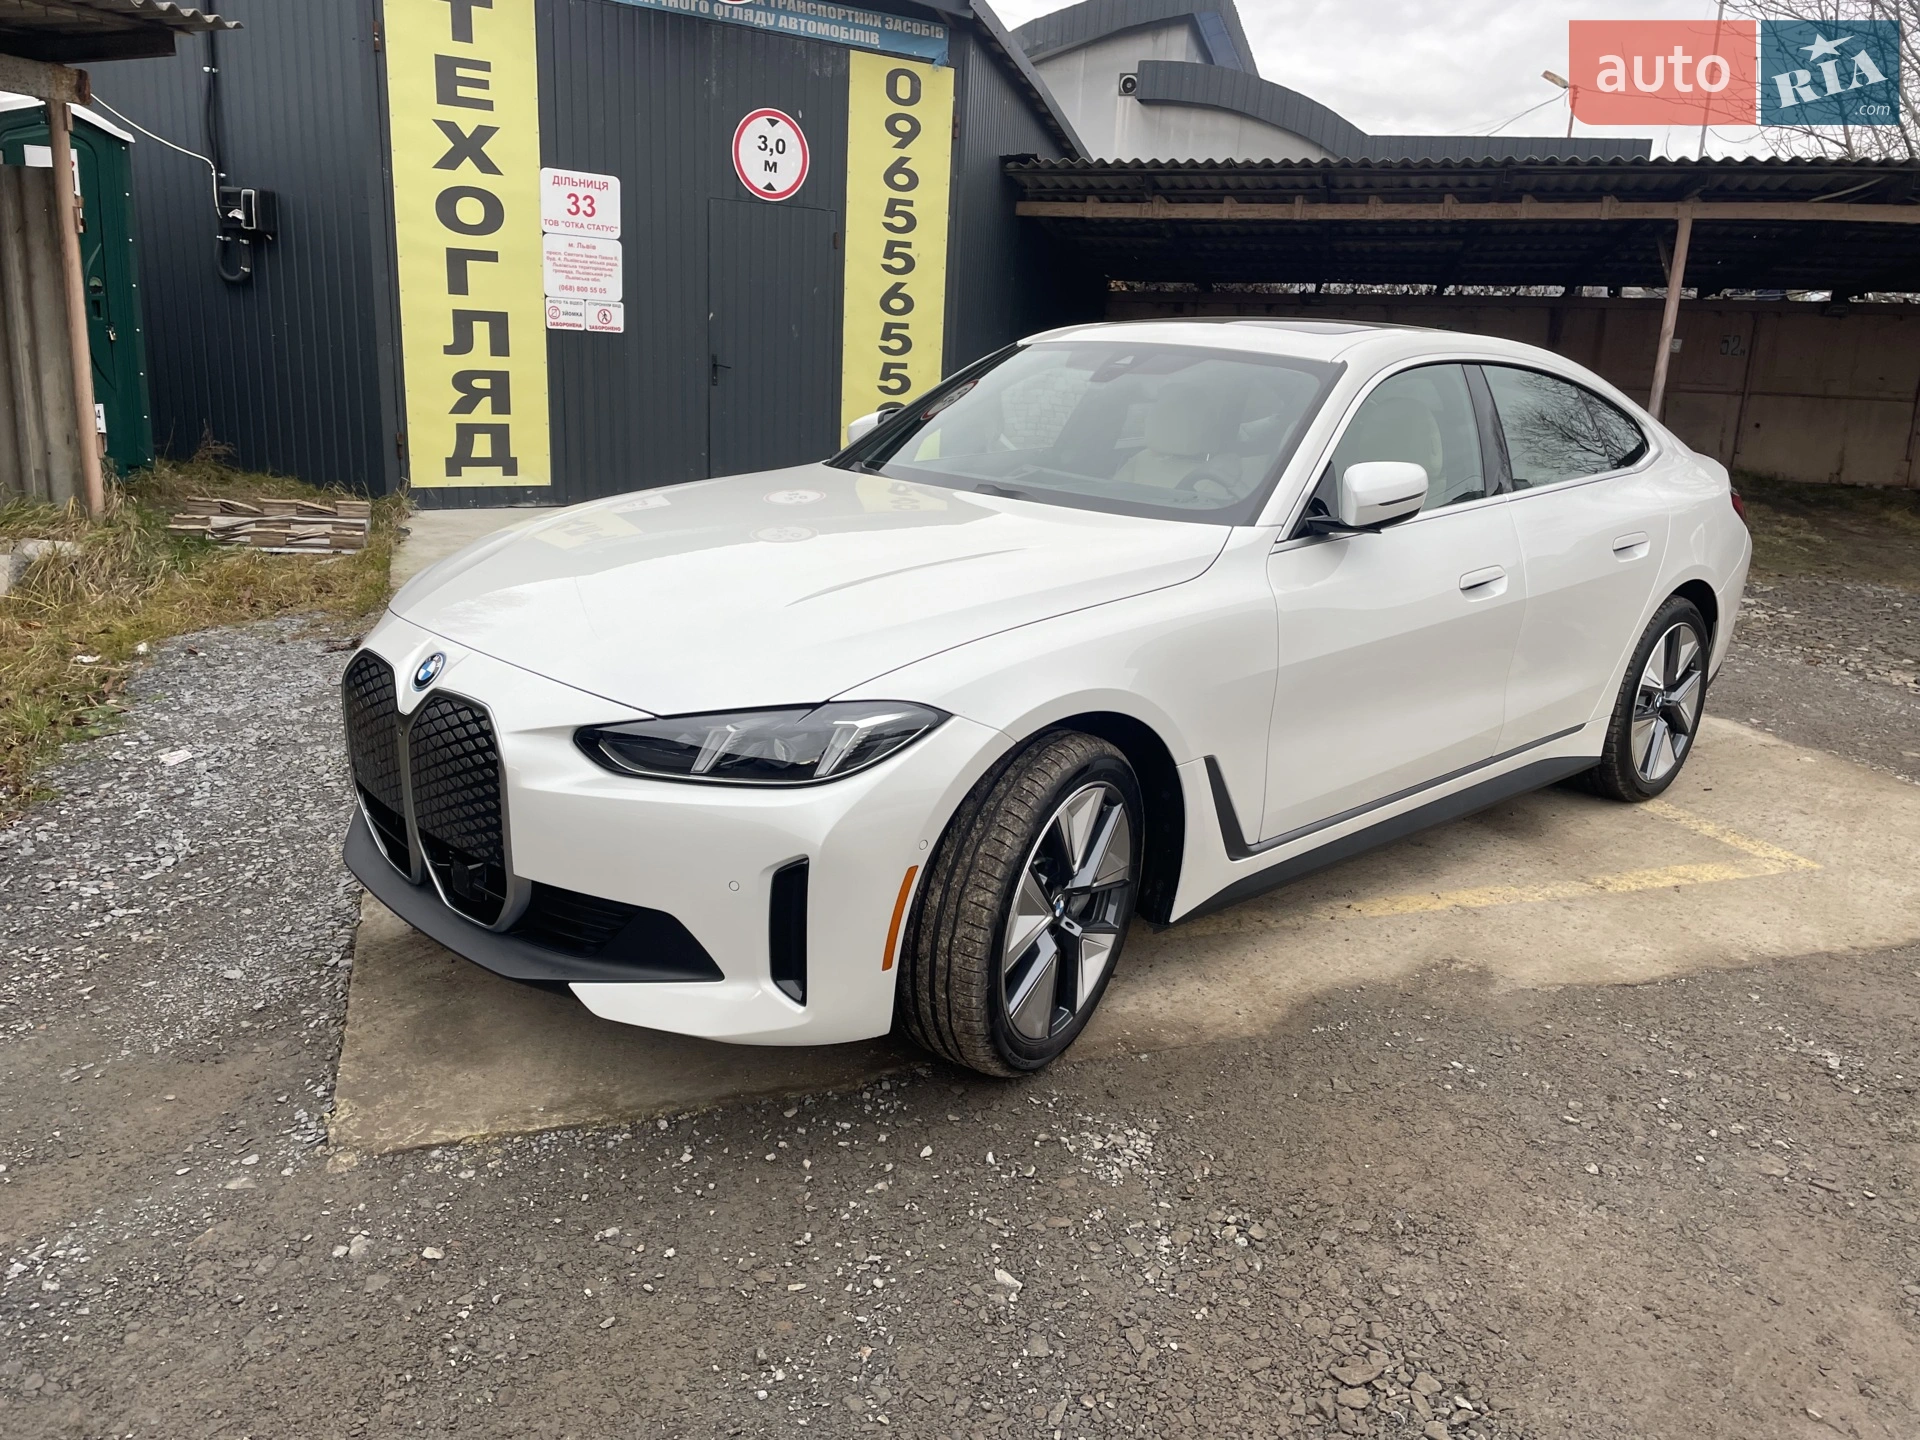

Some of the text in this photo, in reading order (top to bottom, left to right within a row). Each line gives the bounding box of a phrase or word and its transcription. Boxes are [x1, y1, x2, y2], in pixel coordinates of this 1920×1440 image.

[713, 6, 776, 28] ОГЛЯДУ
[778, 15, 880, 45] АВТОМОБІЛІВ
[885, 17, 944, 39] ЗАСОБІВ
[757, 134, 786, 156] 3,0
[552, 175, 609, 191] ДІЛЬНИЦЯ
[566, 192, 596, 217] 33
[544, 218, 618, 233] ТОВ "ОТКА СТАТУС"
[431, 0, 518, 477] ТЕХОГЛЯД
[576, 242, 597, 250] Львів
[876, 67, 922, 411] 09655655
[558, 284, 575, 293] (068)
